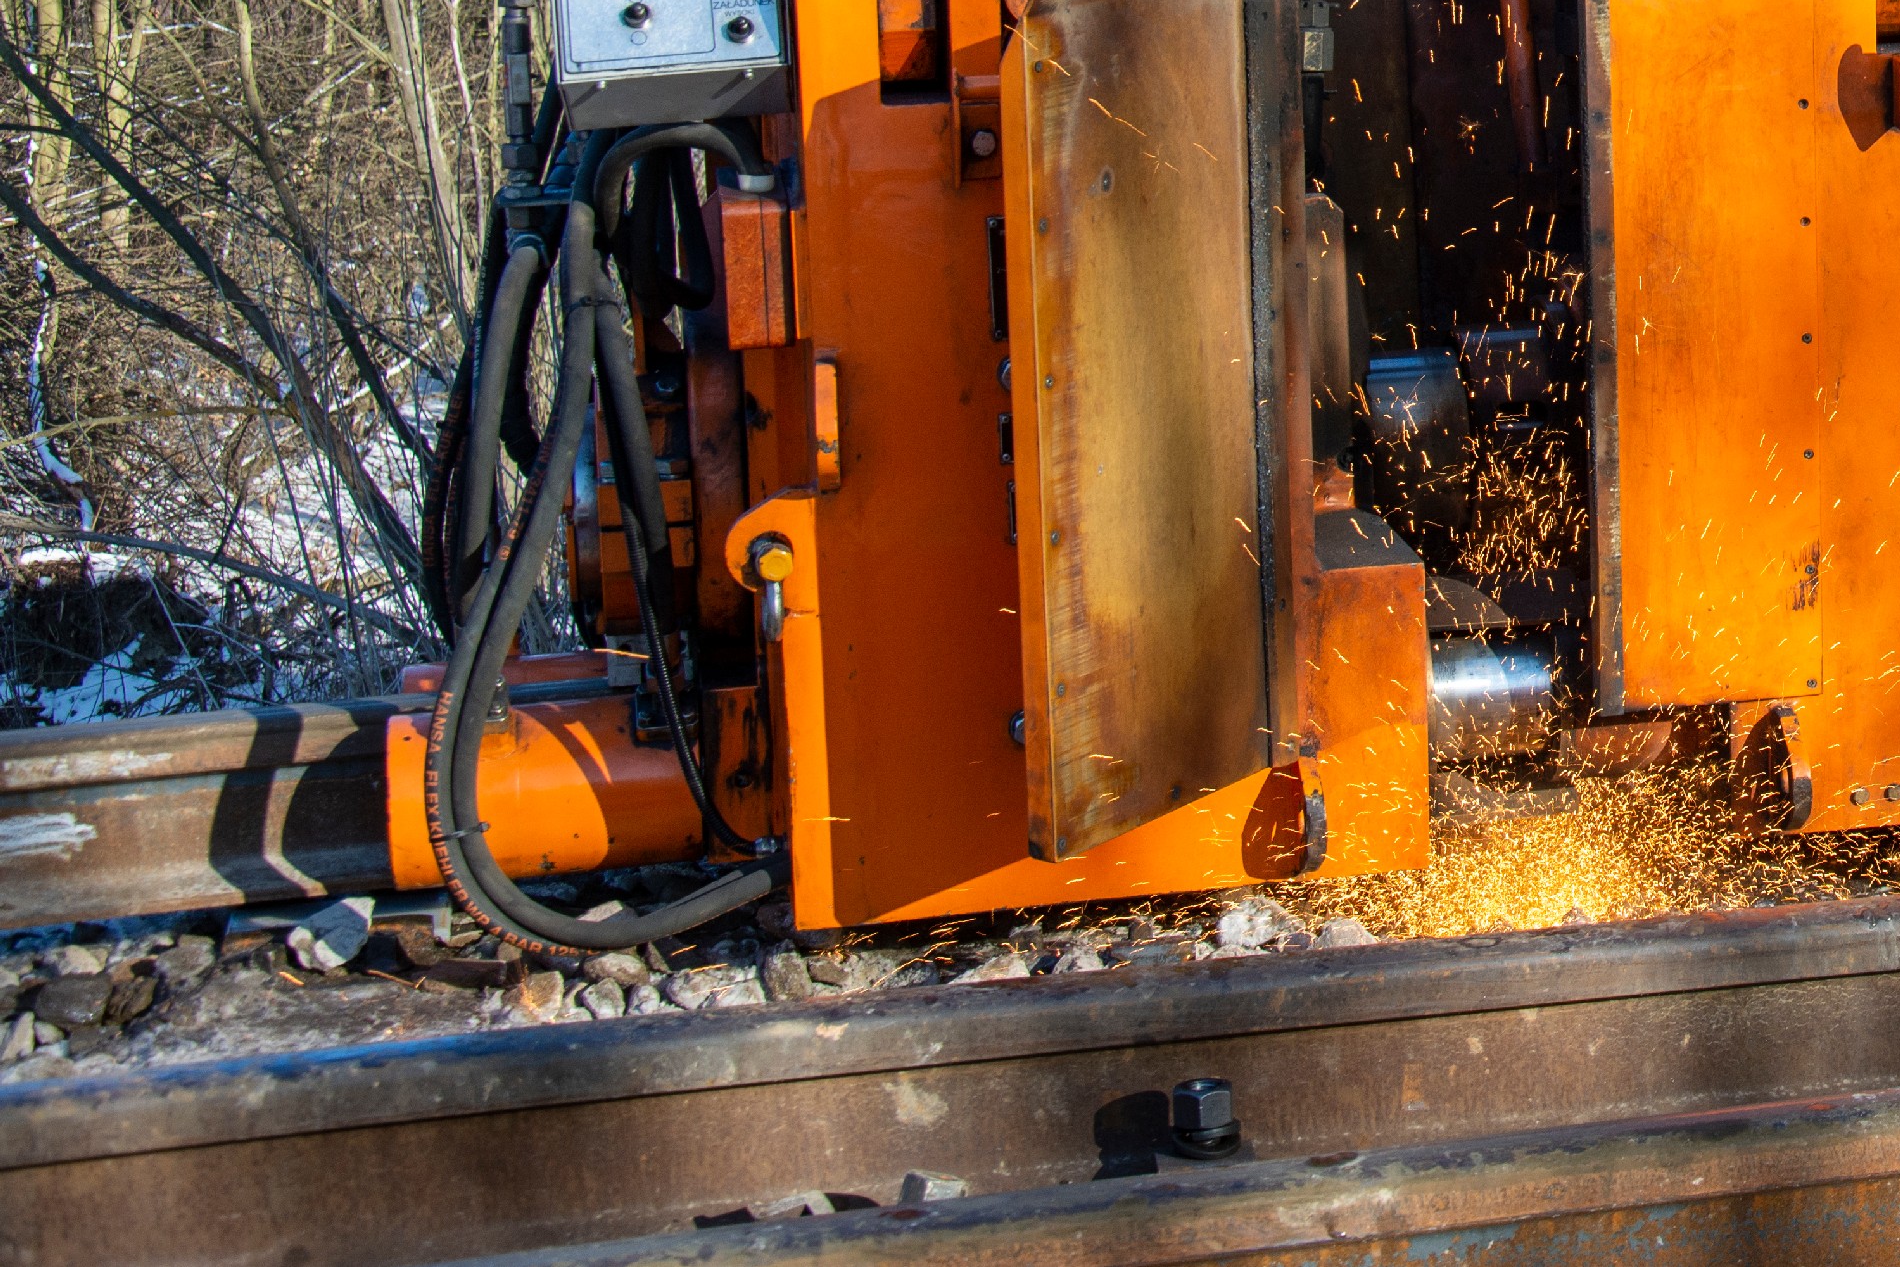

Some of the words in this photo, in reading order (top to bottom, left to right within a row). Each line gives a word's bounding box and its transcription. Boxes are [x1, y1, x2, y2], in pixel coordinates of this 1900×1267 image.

[429, 690, 455, 754] HANSA
[464, 901, 491, 927] WP
[503, 931, 544, 954] BAR
